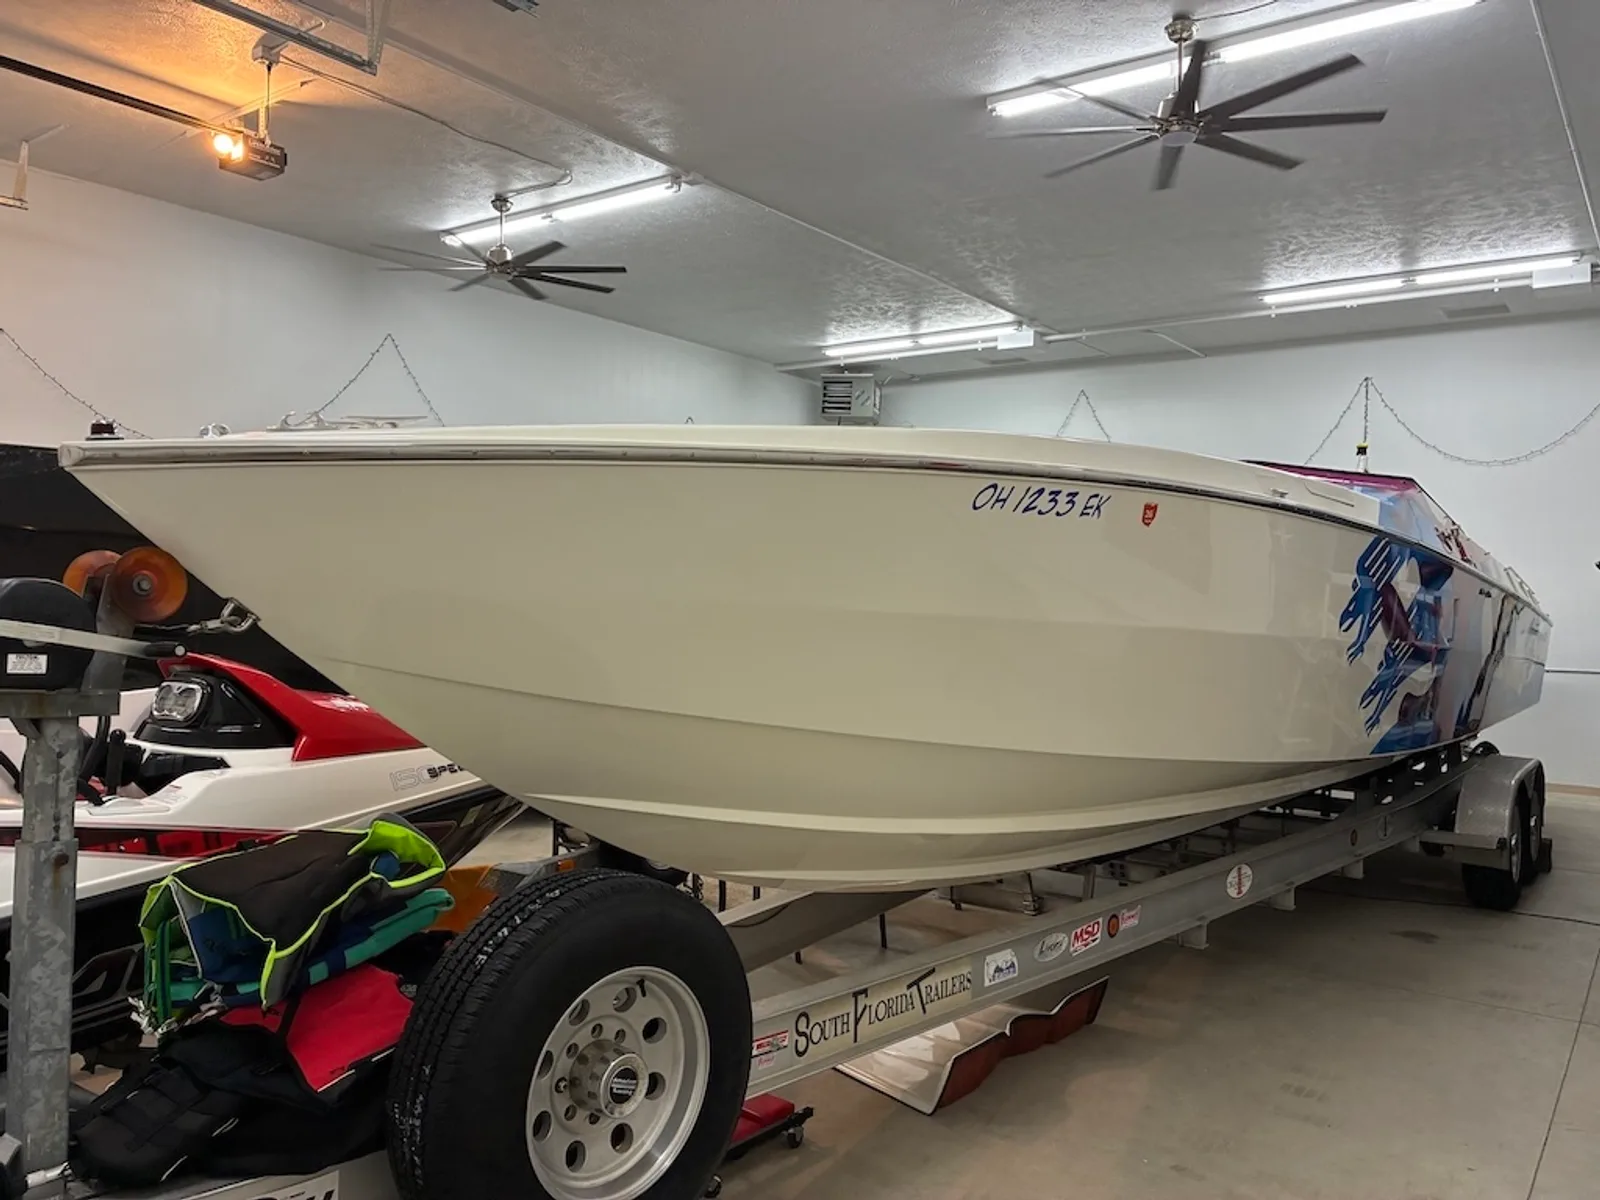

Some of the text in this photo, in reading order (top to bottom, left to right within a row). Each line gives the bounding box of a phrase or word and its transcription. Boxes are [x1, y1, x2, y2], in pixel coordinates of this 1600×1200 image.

[971, 483, 1014, 511] OH
[1012, 486, 1079, 517] 1233
[1079, 493, 1112, 519] EK
[1072, 920, 1100, 948] MSD
[794, 967, 972, 1057] SOUTH FLORIDA TRAILERS
